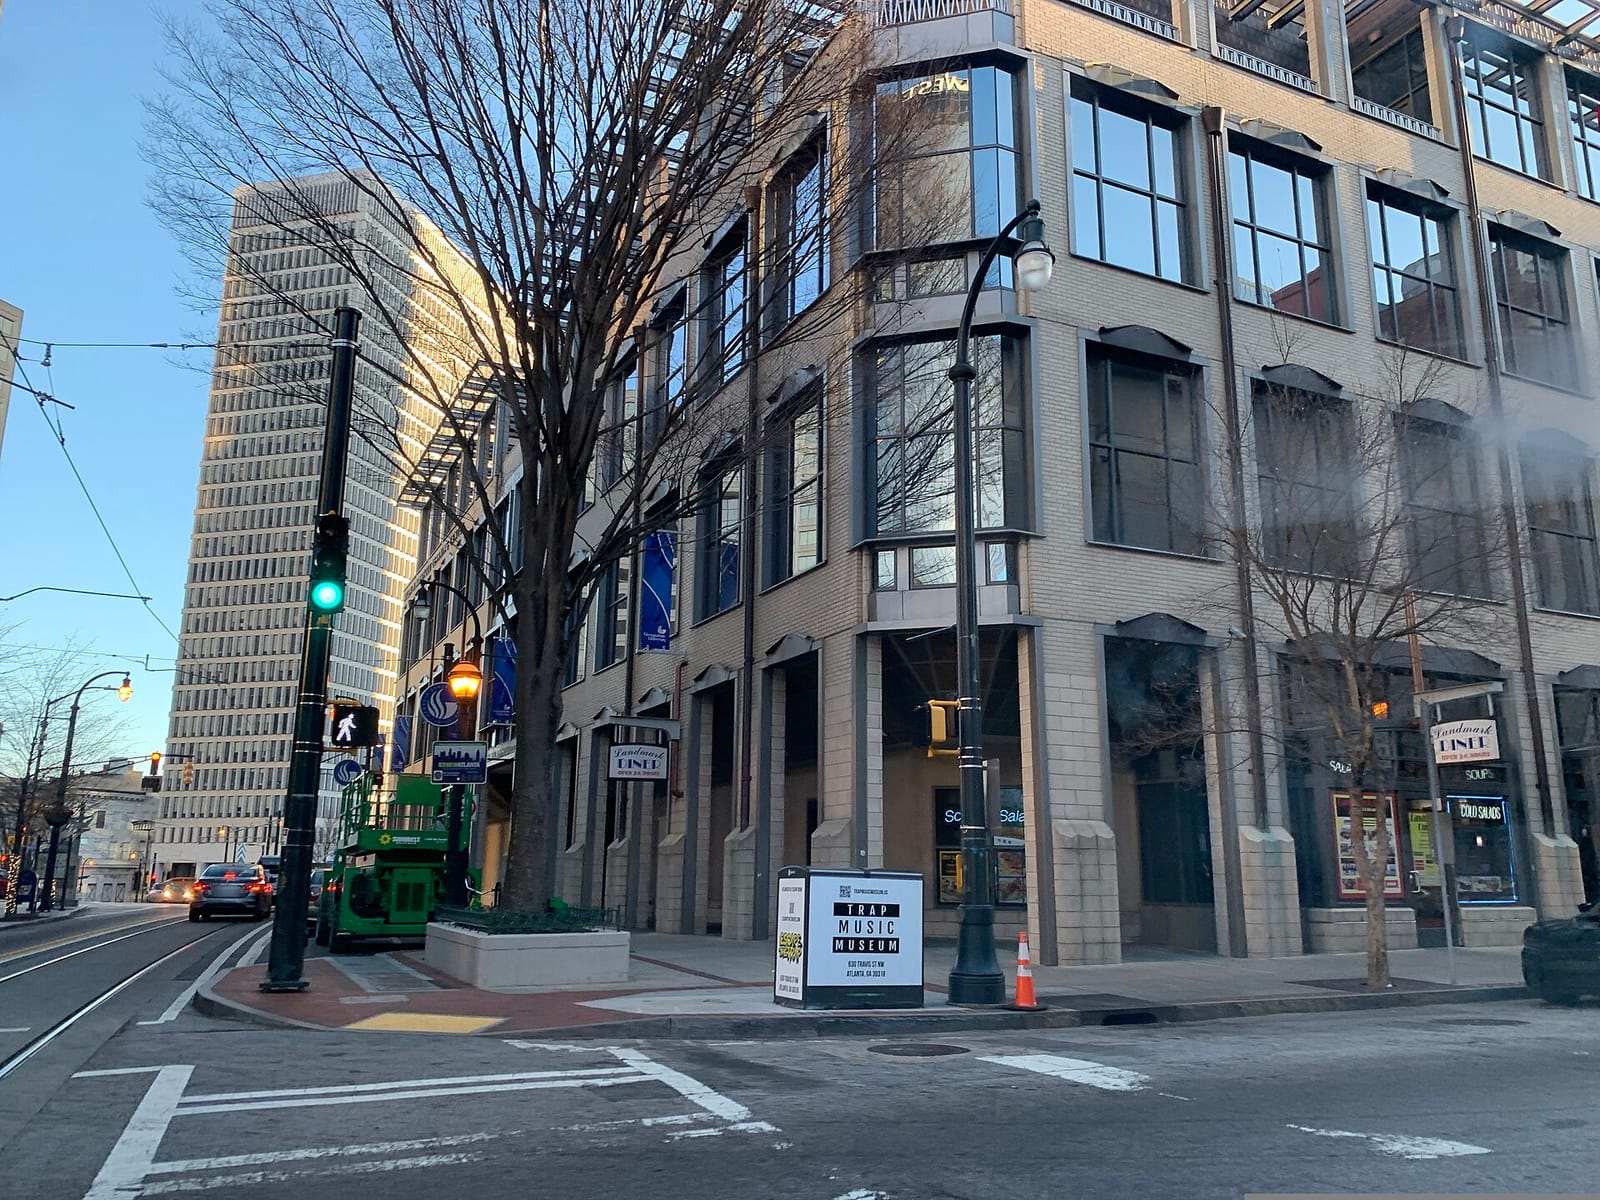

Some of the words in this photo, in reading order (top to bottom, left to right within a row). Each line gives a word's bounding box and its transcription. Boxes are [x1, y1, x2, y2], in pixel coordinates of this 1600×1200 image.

[1434, 722, 1492, 738] Landmark
[1440, 736, 1488, 752] DINER
[614, 746, 665, 760] Landmark
[617, 758, 662, 770] DINER
[1465, 768, 1495, 781] SOUPS
[1460, 804, 1478, 818] COLD
[1478, 805, 1502, 820] SALADS
[847, 904, 887, 916] TRAP
[838, 919, 894, 935] MUSIC
[835, 939, 897, 952] MUSEUM
